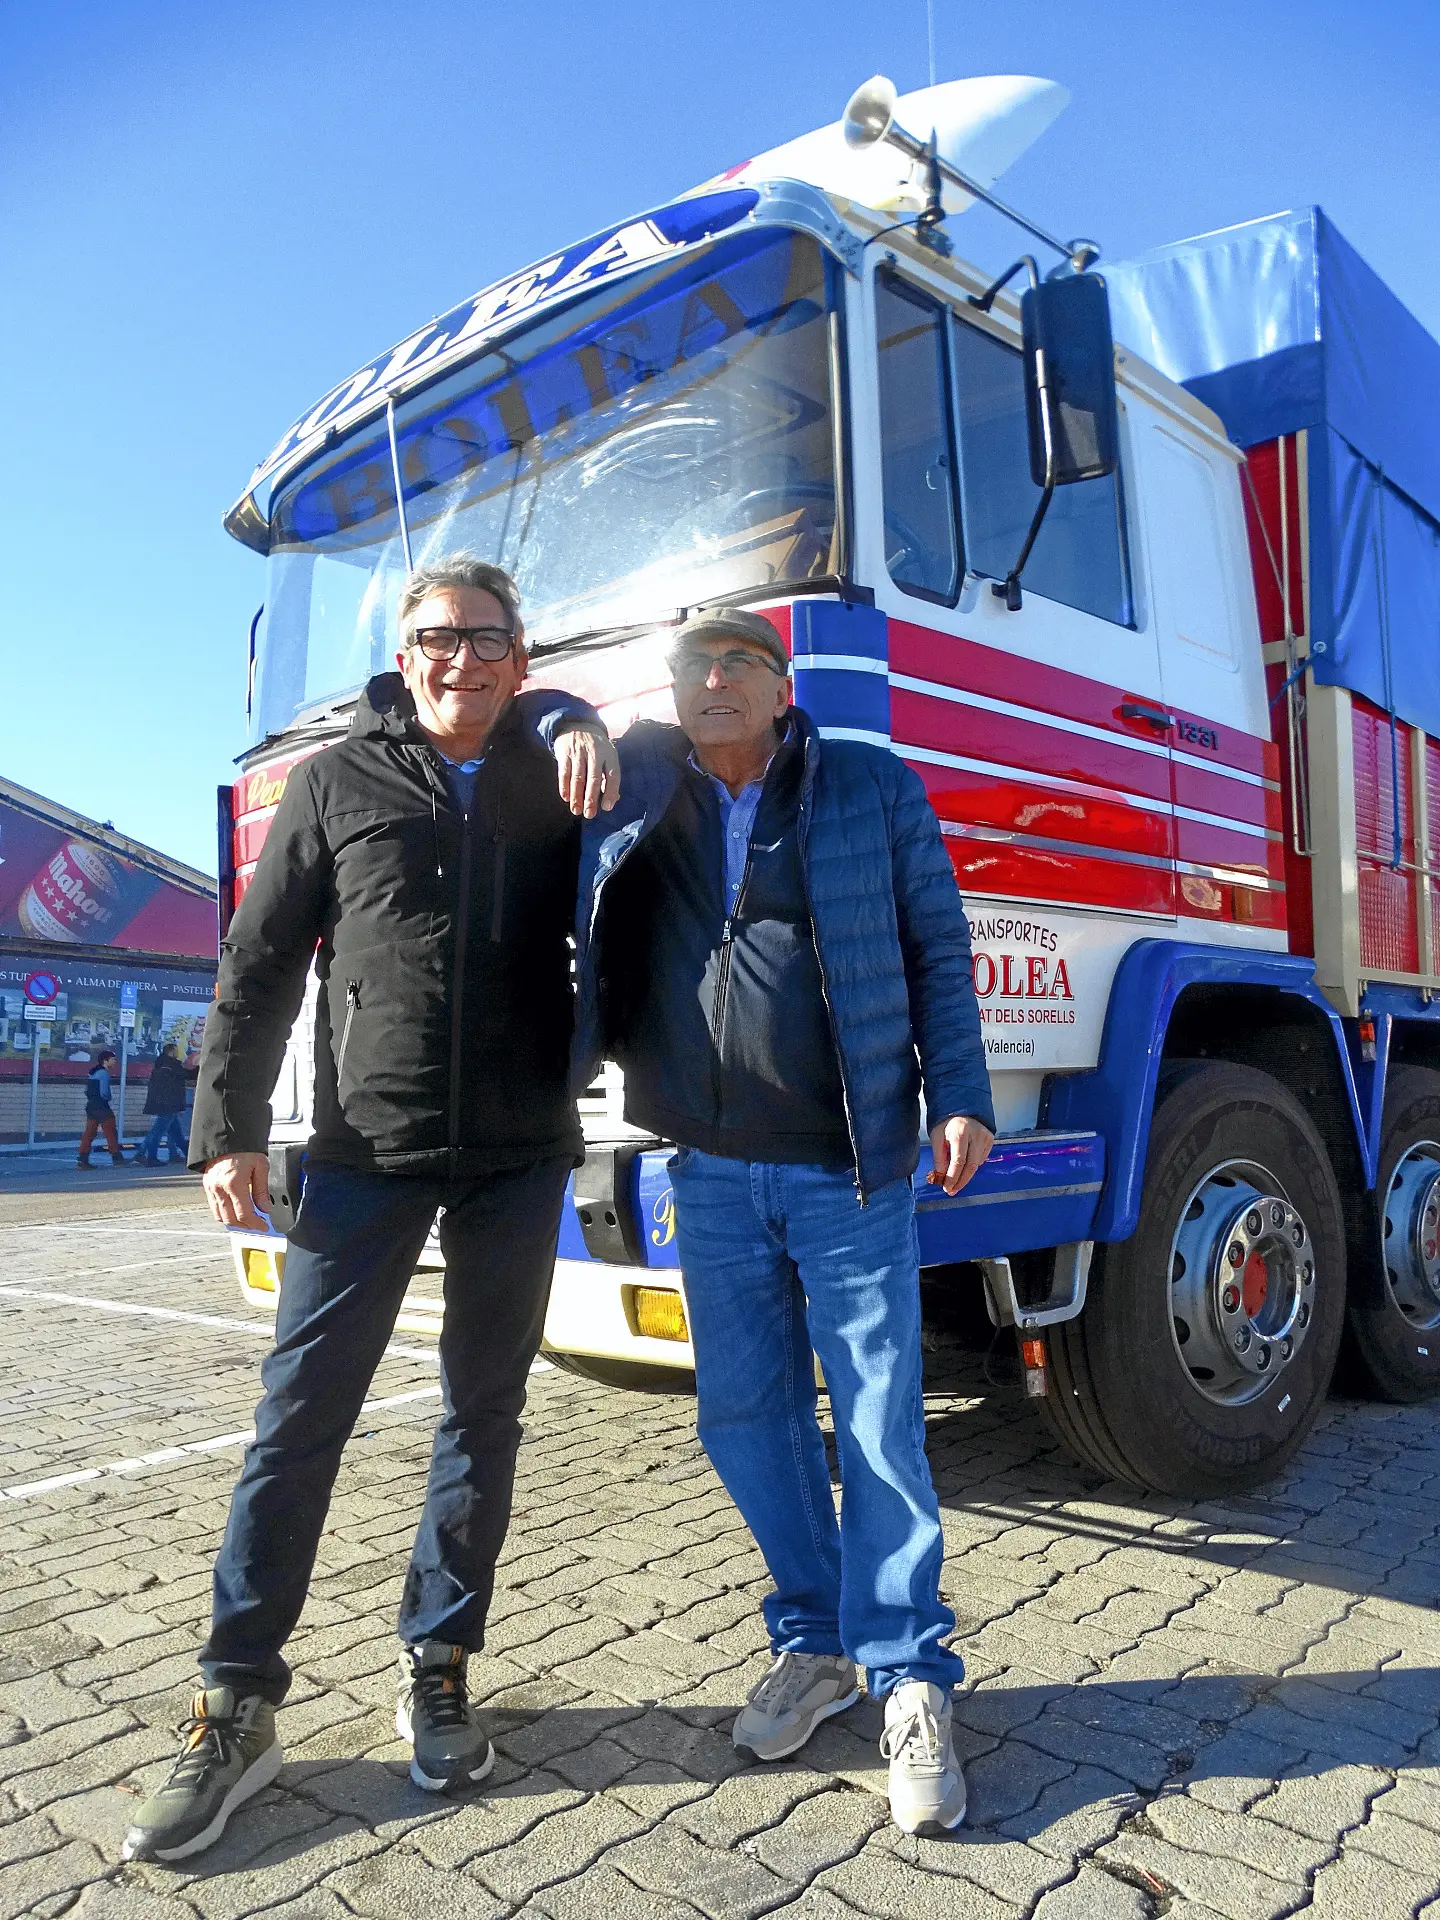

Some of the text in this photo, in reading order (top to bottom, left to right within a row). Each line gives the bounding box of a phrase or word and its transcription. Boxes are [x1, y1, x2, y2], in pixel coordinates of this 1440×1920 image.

[1177, 719, 1218, 750] 1331
[76, 977, 105, 988] ALMA
[108, 979, 121, 989] DE
[995, 1008, 1025, 1023] DELS
[1027, 1009, 1075, 1024] SORELLS
[983, 1038, 1035, 1056] (Valencia)
